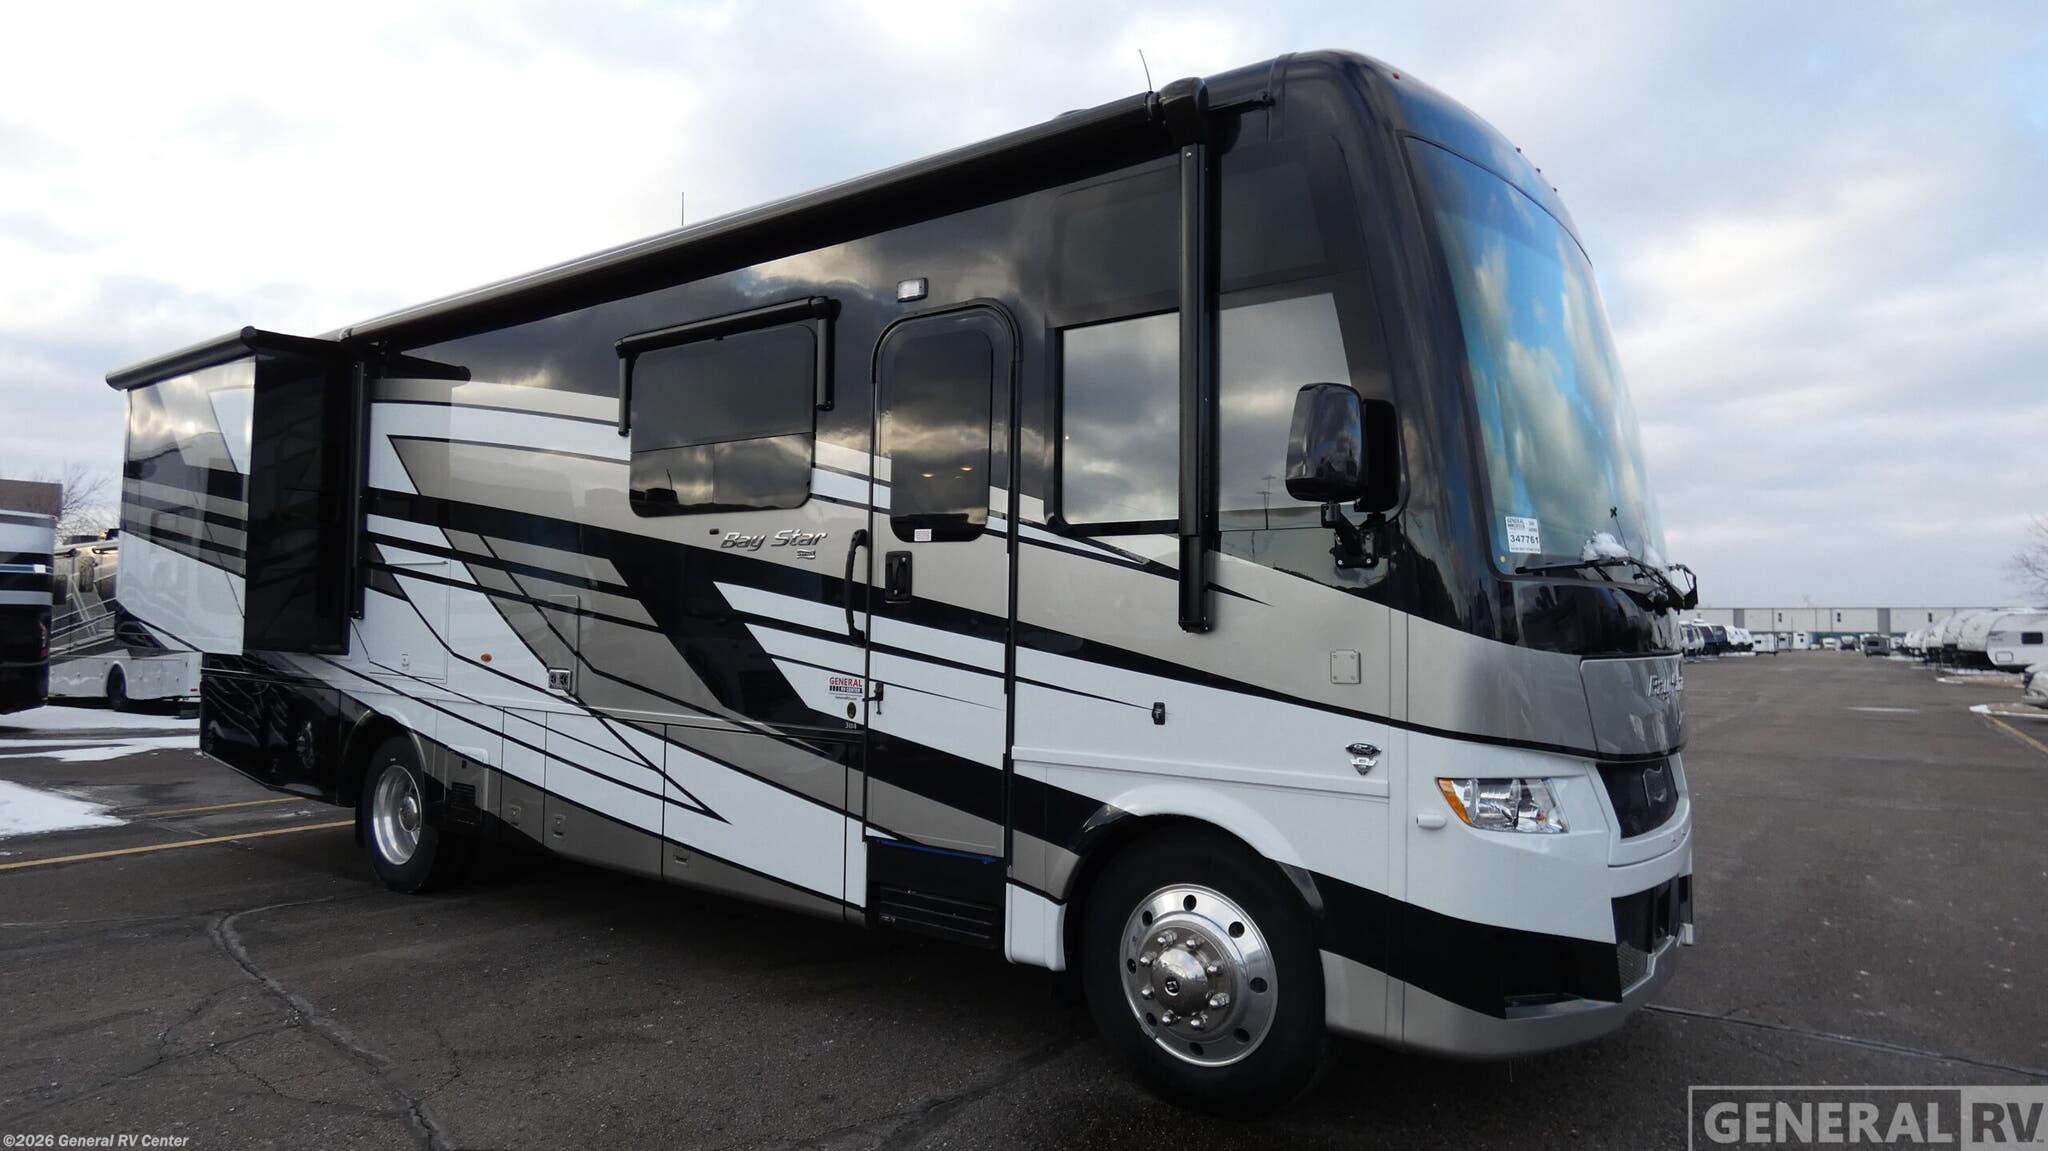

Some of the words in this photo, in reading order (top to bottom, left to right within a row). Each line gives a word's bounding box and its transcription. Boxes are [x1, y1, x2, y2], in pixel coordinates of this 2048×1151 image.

[720, 531, 766, 551] Bay
[771, 528, 827, 547] Star
[1510, 534, 1539, 544] 347761
[829, 677, 862, 687] GENERAL
